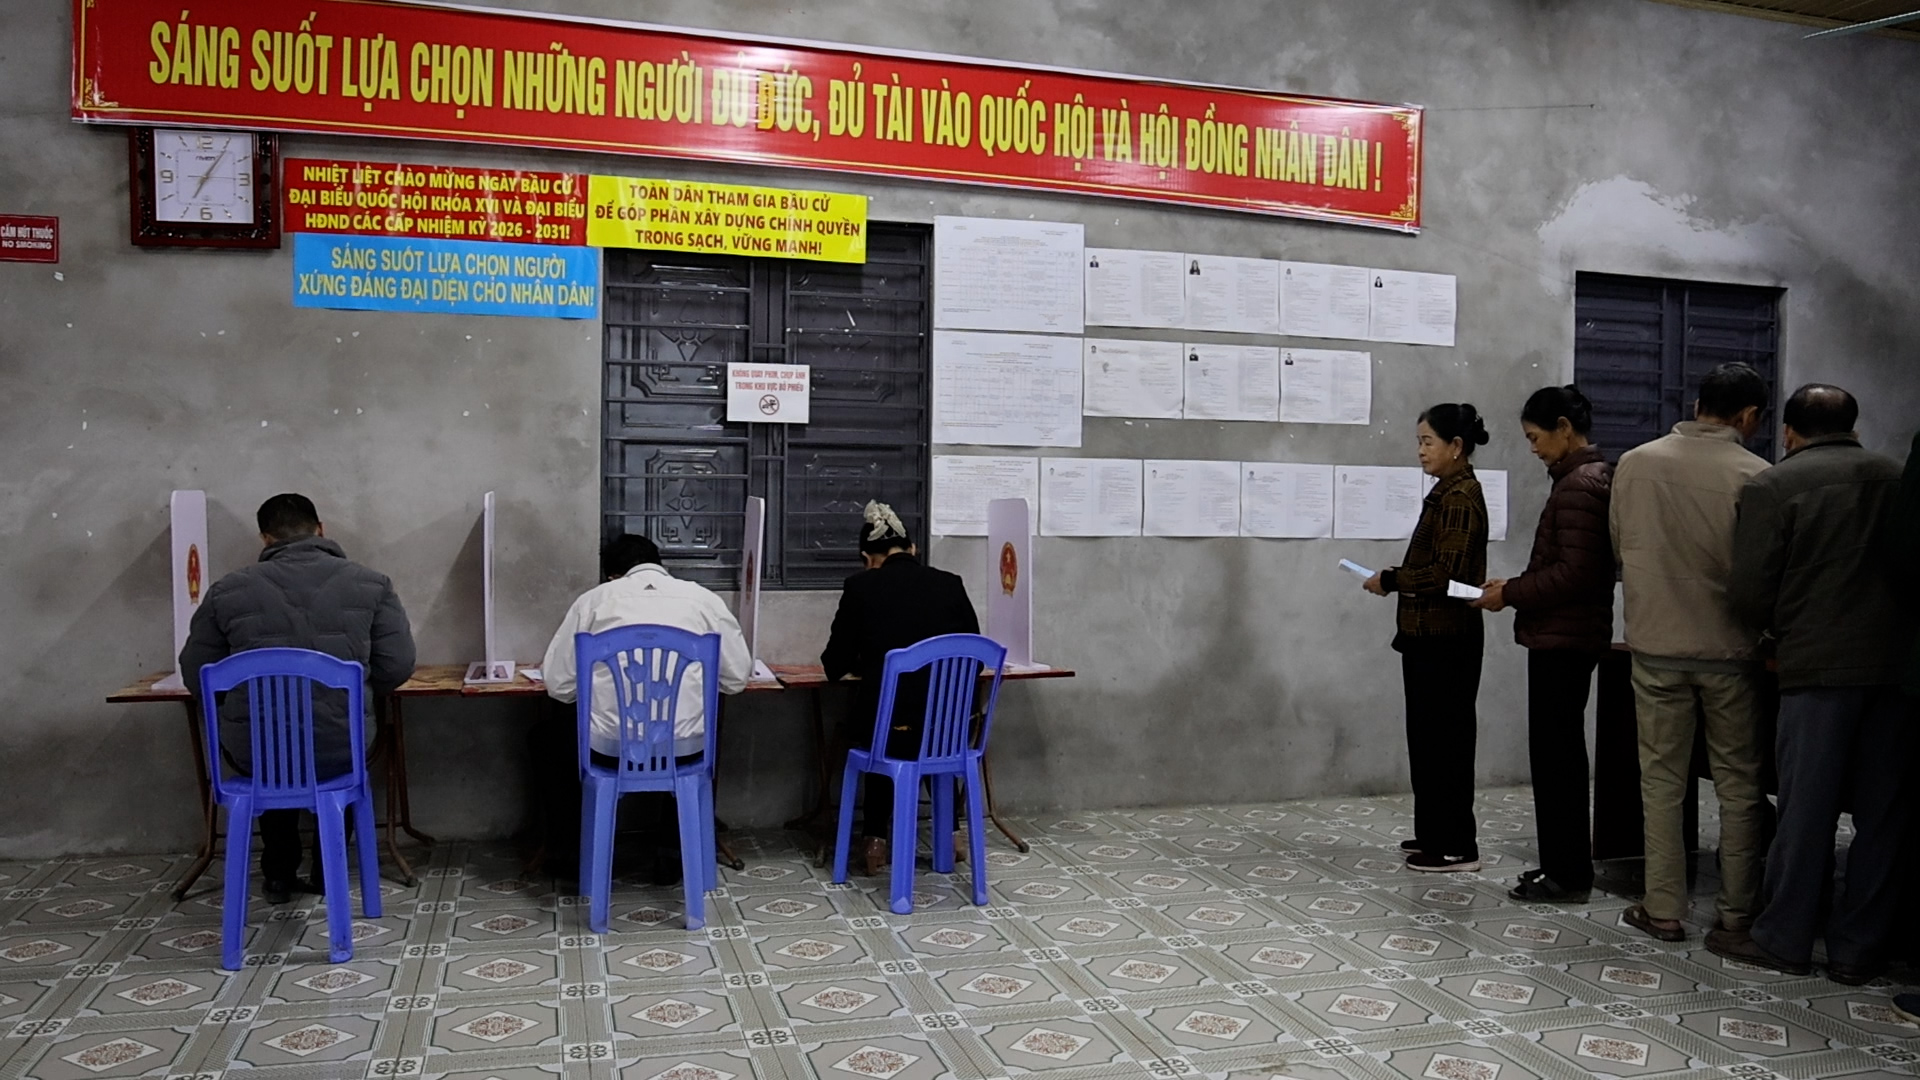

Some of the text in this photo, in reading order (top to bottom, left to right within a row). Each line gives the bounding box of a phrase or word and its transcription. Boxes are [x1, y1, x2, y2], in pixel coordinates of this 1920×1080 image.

[150, 10, 240, 90] SÁNG
[250, 12, 333, 95] SUỐT
[342, 33, 400, 112] LỰA
[410, 41, 494, 119] CHỌN
[503, 42, 607, 117] NHỮNG
[615, 51, 703, 125] NGƯỜI
[711, 51, 748, 128] ĐỦ
[828, 62, 866, 138] ĐỦ
[873, 73, 914, 142] TÀI
[922, 78, 971, 148] VÀO
[979, 79, 1046, 158] QUỐC
[1053, 93, 1095, 172] HỘI
[1102, 99, 1133, 163] VÀ
[1139, 103, 1180, 180] HỘI
[1185, 102, 1249, 178] ĐỒNG
[1255, 120, 1317, 185] NHÂN
[1323, 126, 1369, 191] DÂN
[1374, 141, 1383, 192] !
[197, 136, 214, 149] 12
[160, 170, 173, 183] 9
[238, 173, 250, 186] 3
[304, 163, 573, 195] NHIỆT LIỆT CHÀO MỪNG NGÀY BẦU CỬ
[289, 187, 585, 219] ĐẠI BIỂU QUỐC HỘI KHÓA XVI VÀ ĐẠI BIỂU
[630, 182, 832, 212] TOÀN DÂN THAM GIA BẦU CỬ
[200, 207, 213, 220] 6
[306, 213, 350, 230] HĐND
[353, 213, 382, 232] CÁC
[385, 212, 414, 233] CẤP
[417, 215, 465, 237] NHIỆM
[469, 214, 488, 236] KỲ
[490, 222, 523, 238] 2026
[536, 223, 570, 240] 2031!
[596, 200, 860, 237] ĐỂ GÓP PHẦN XÂY DỰNG CHÍNH QUYỀN
[0, 224, 53, 239] CẤM HÚT THUỐC
[1, 240, 52, 250] NO SMOKING
[636, 230, 822, 256] TRONG SẠCH, VỮNG MẠNH!
[331, 242, 566, 279] SÁNG SUỐT LỰA CHỌN NGƯỜI
[298, 270, 594, 307] XỨNG ĐÁNG ĐẠI DIỆN CHO NHÂN DÂN!
[736, 382, 753, 390] TRONG
[755, 382, 765, 390] KHU
